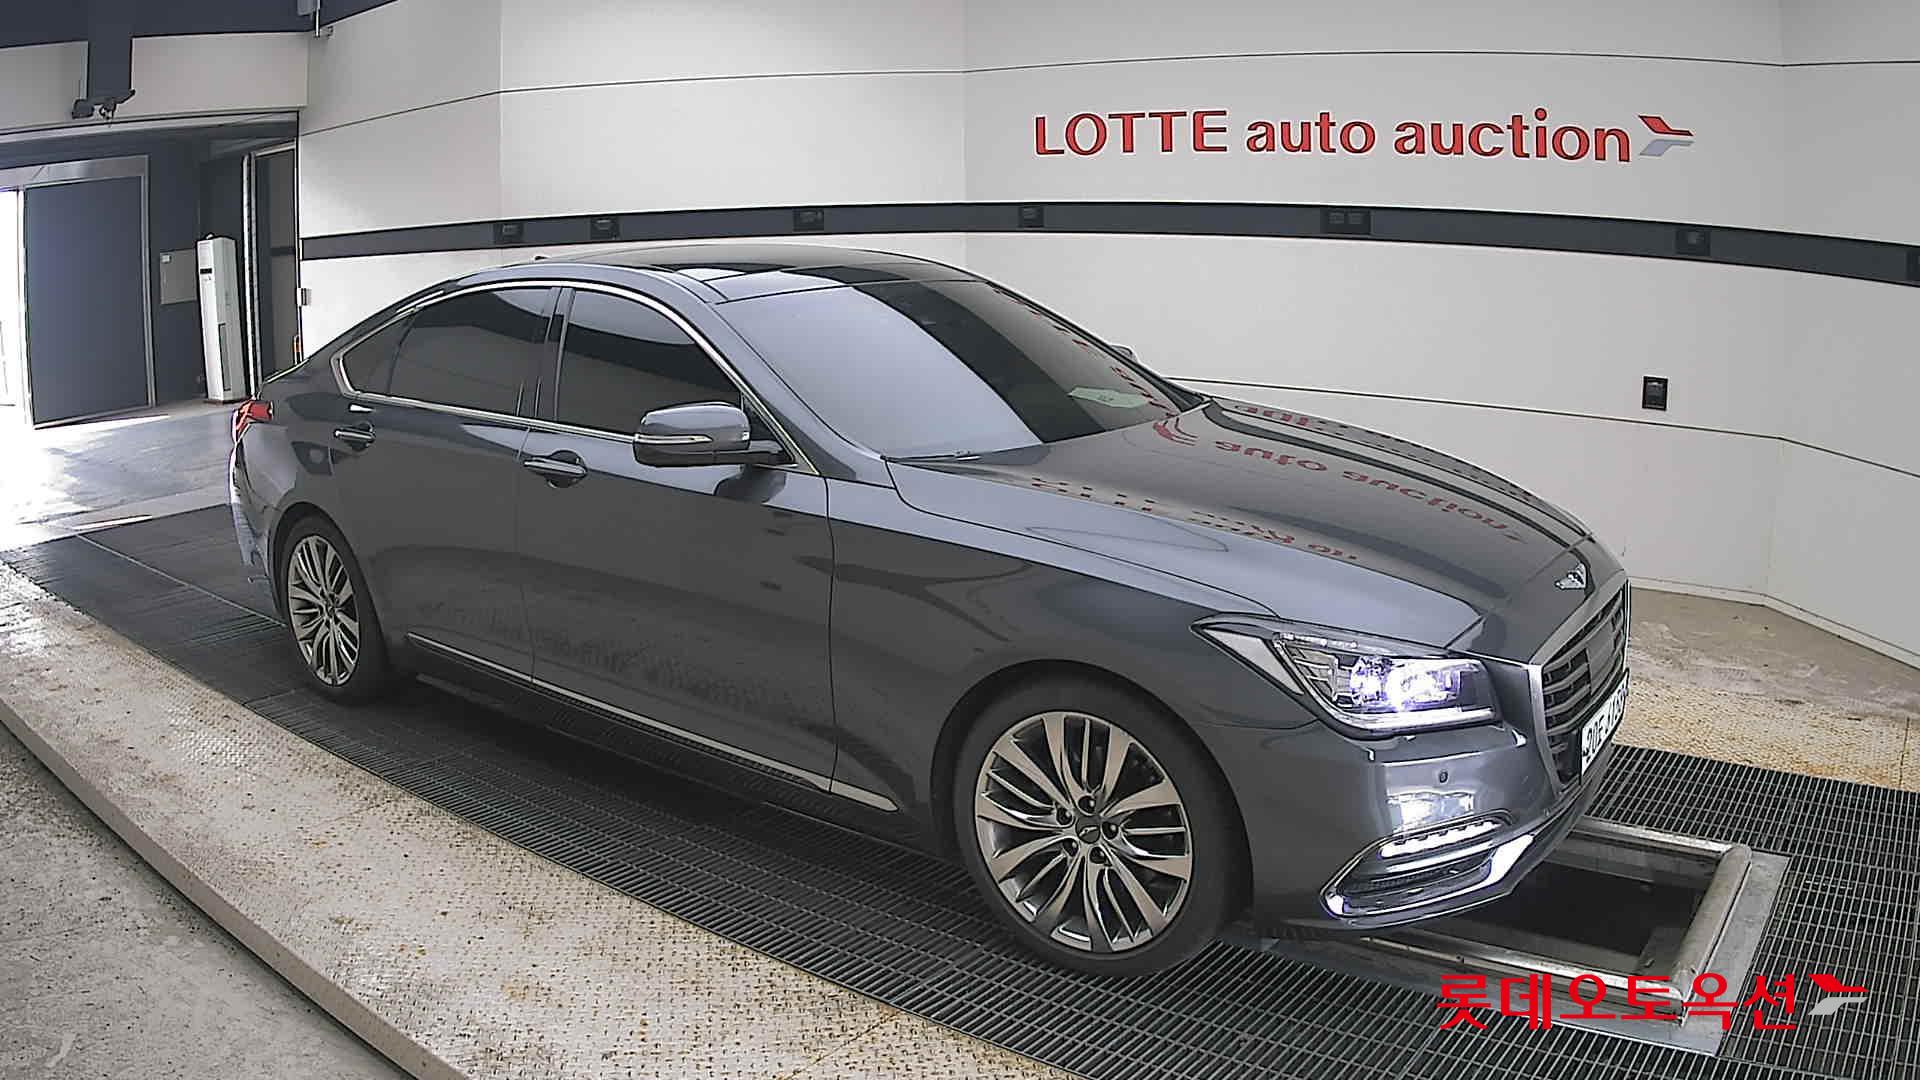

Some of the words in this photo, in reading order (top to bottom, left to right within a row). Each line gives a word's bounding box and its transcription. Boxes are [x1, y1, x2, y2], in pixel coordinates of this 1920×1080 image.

[1034, 110, 1228, 156] LOTTE
[1246, 111, 1376, 155] auto
[1394, 109, 1631, 163] auction
